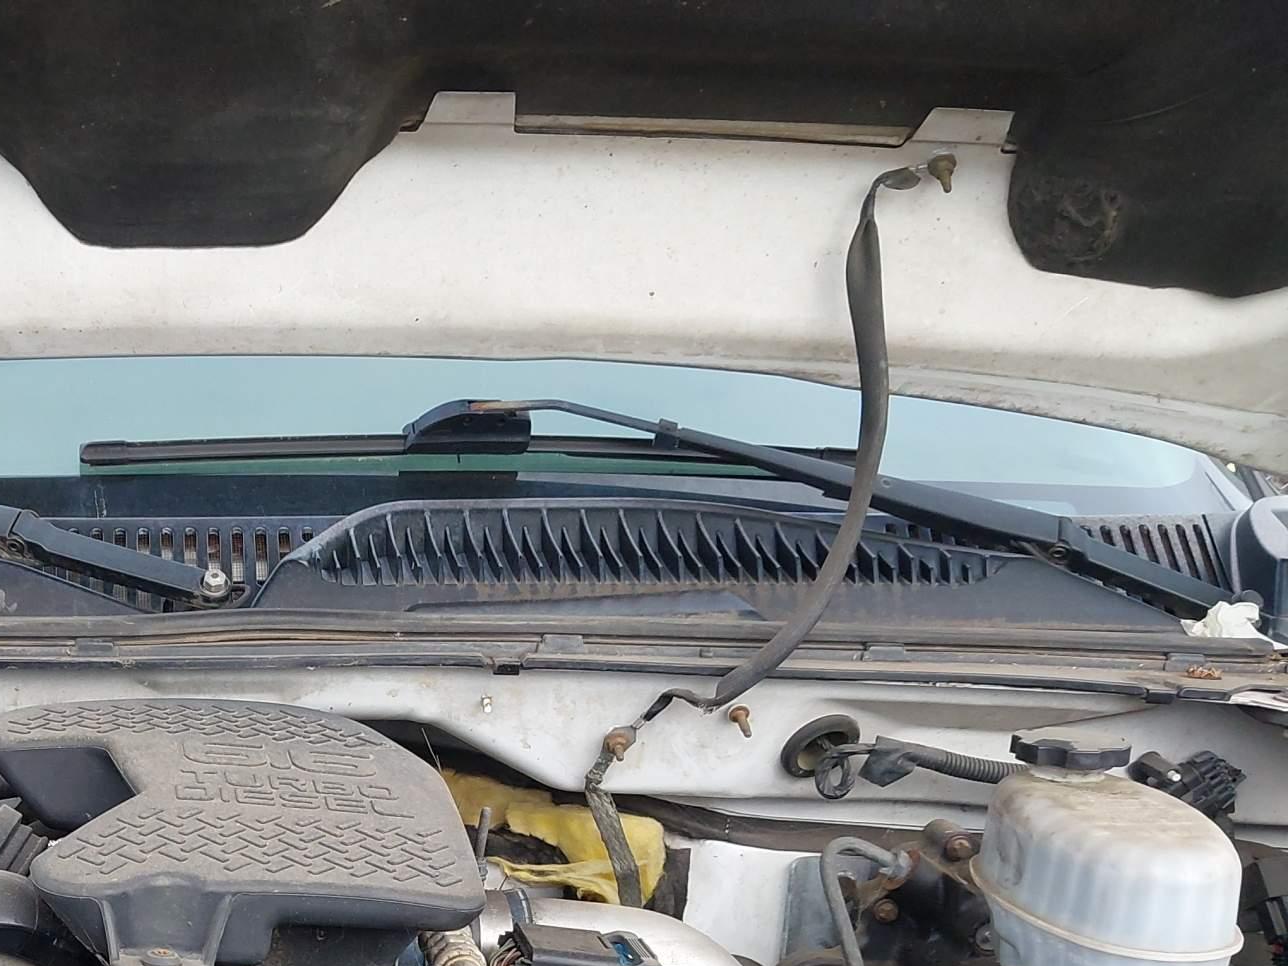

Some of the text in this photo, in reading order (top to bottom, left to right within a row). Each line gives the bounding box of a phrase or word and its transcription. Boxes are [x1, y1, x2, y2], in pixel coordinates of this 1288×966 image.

[180, 741, 377, 778] 6.6
[175, 784, 415, 820] DIESEL
[180, 768, 400, 801] TURBO
